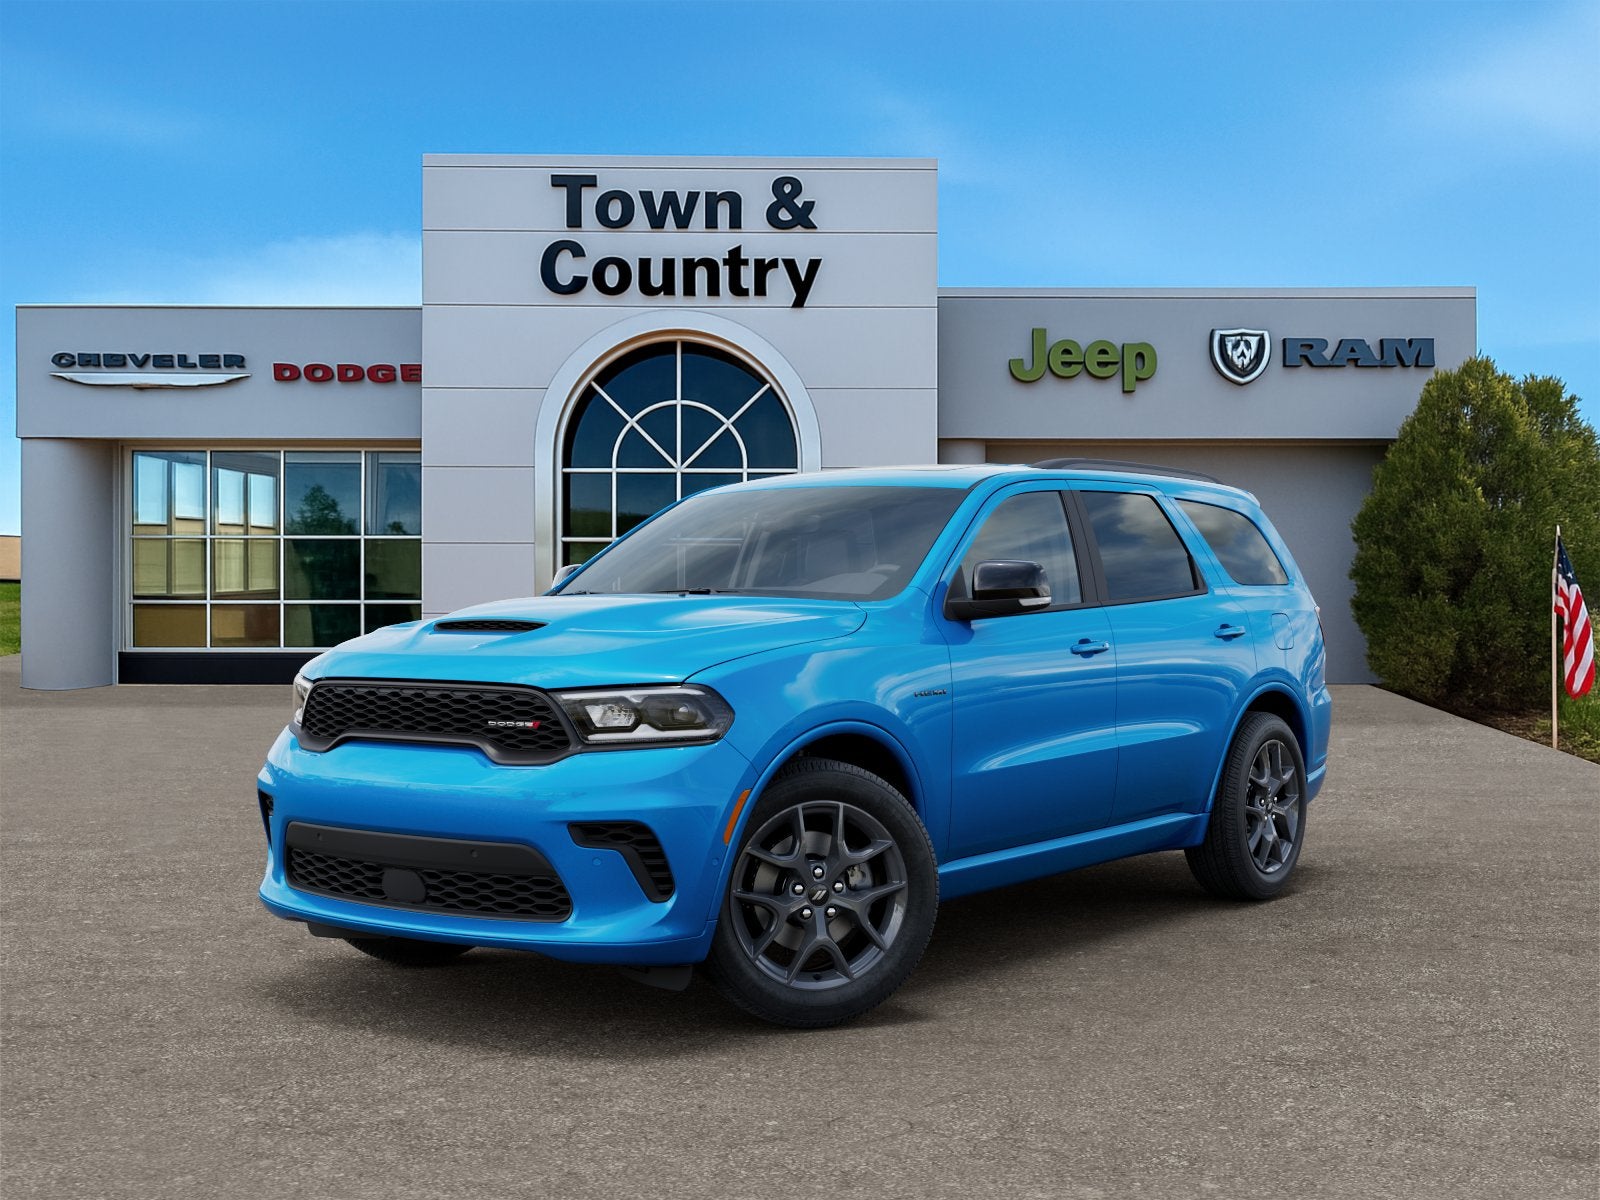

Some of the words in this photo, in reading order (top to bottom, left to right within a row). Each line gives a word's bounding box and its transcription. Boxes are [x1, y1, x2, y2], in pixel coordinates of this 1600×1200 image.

[551, 174, 742, 229] Town
[765, 176, 818, 230] &
[540, 239, 822, 308] Country
[273, 363, 421, 383] DODGE
[1009, 328, 1158, 393] Jeep
[1283, 337, 1436, 368] RAM
